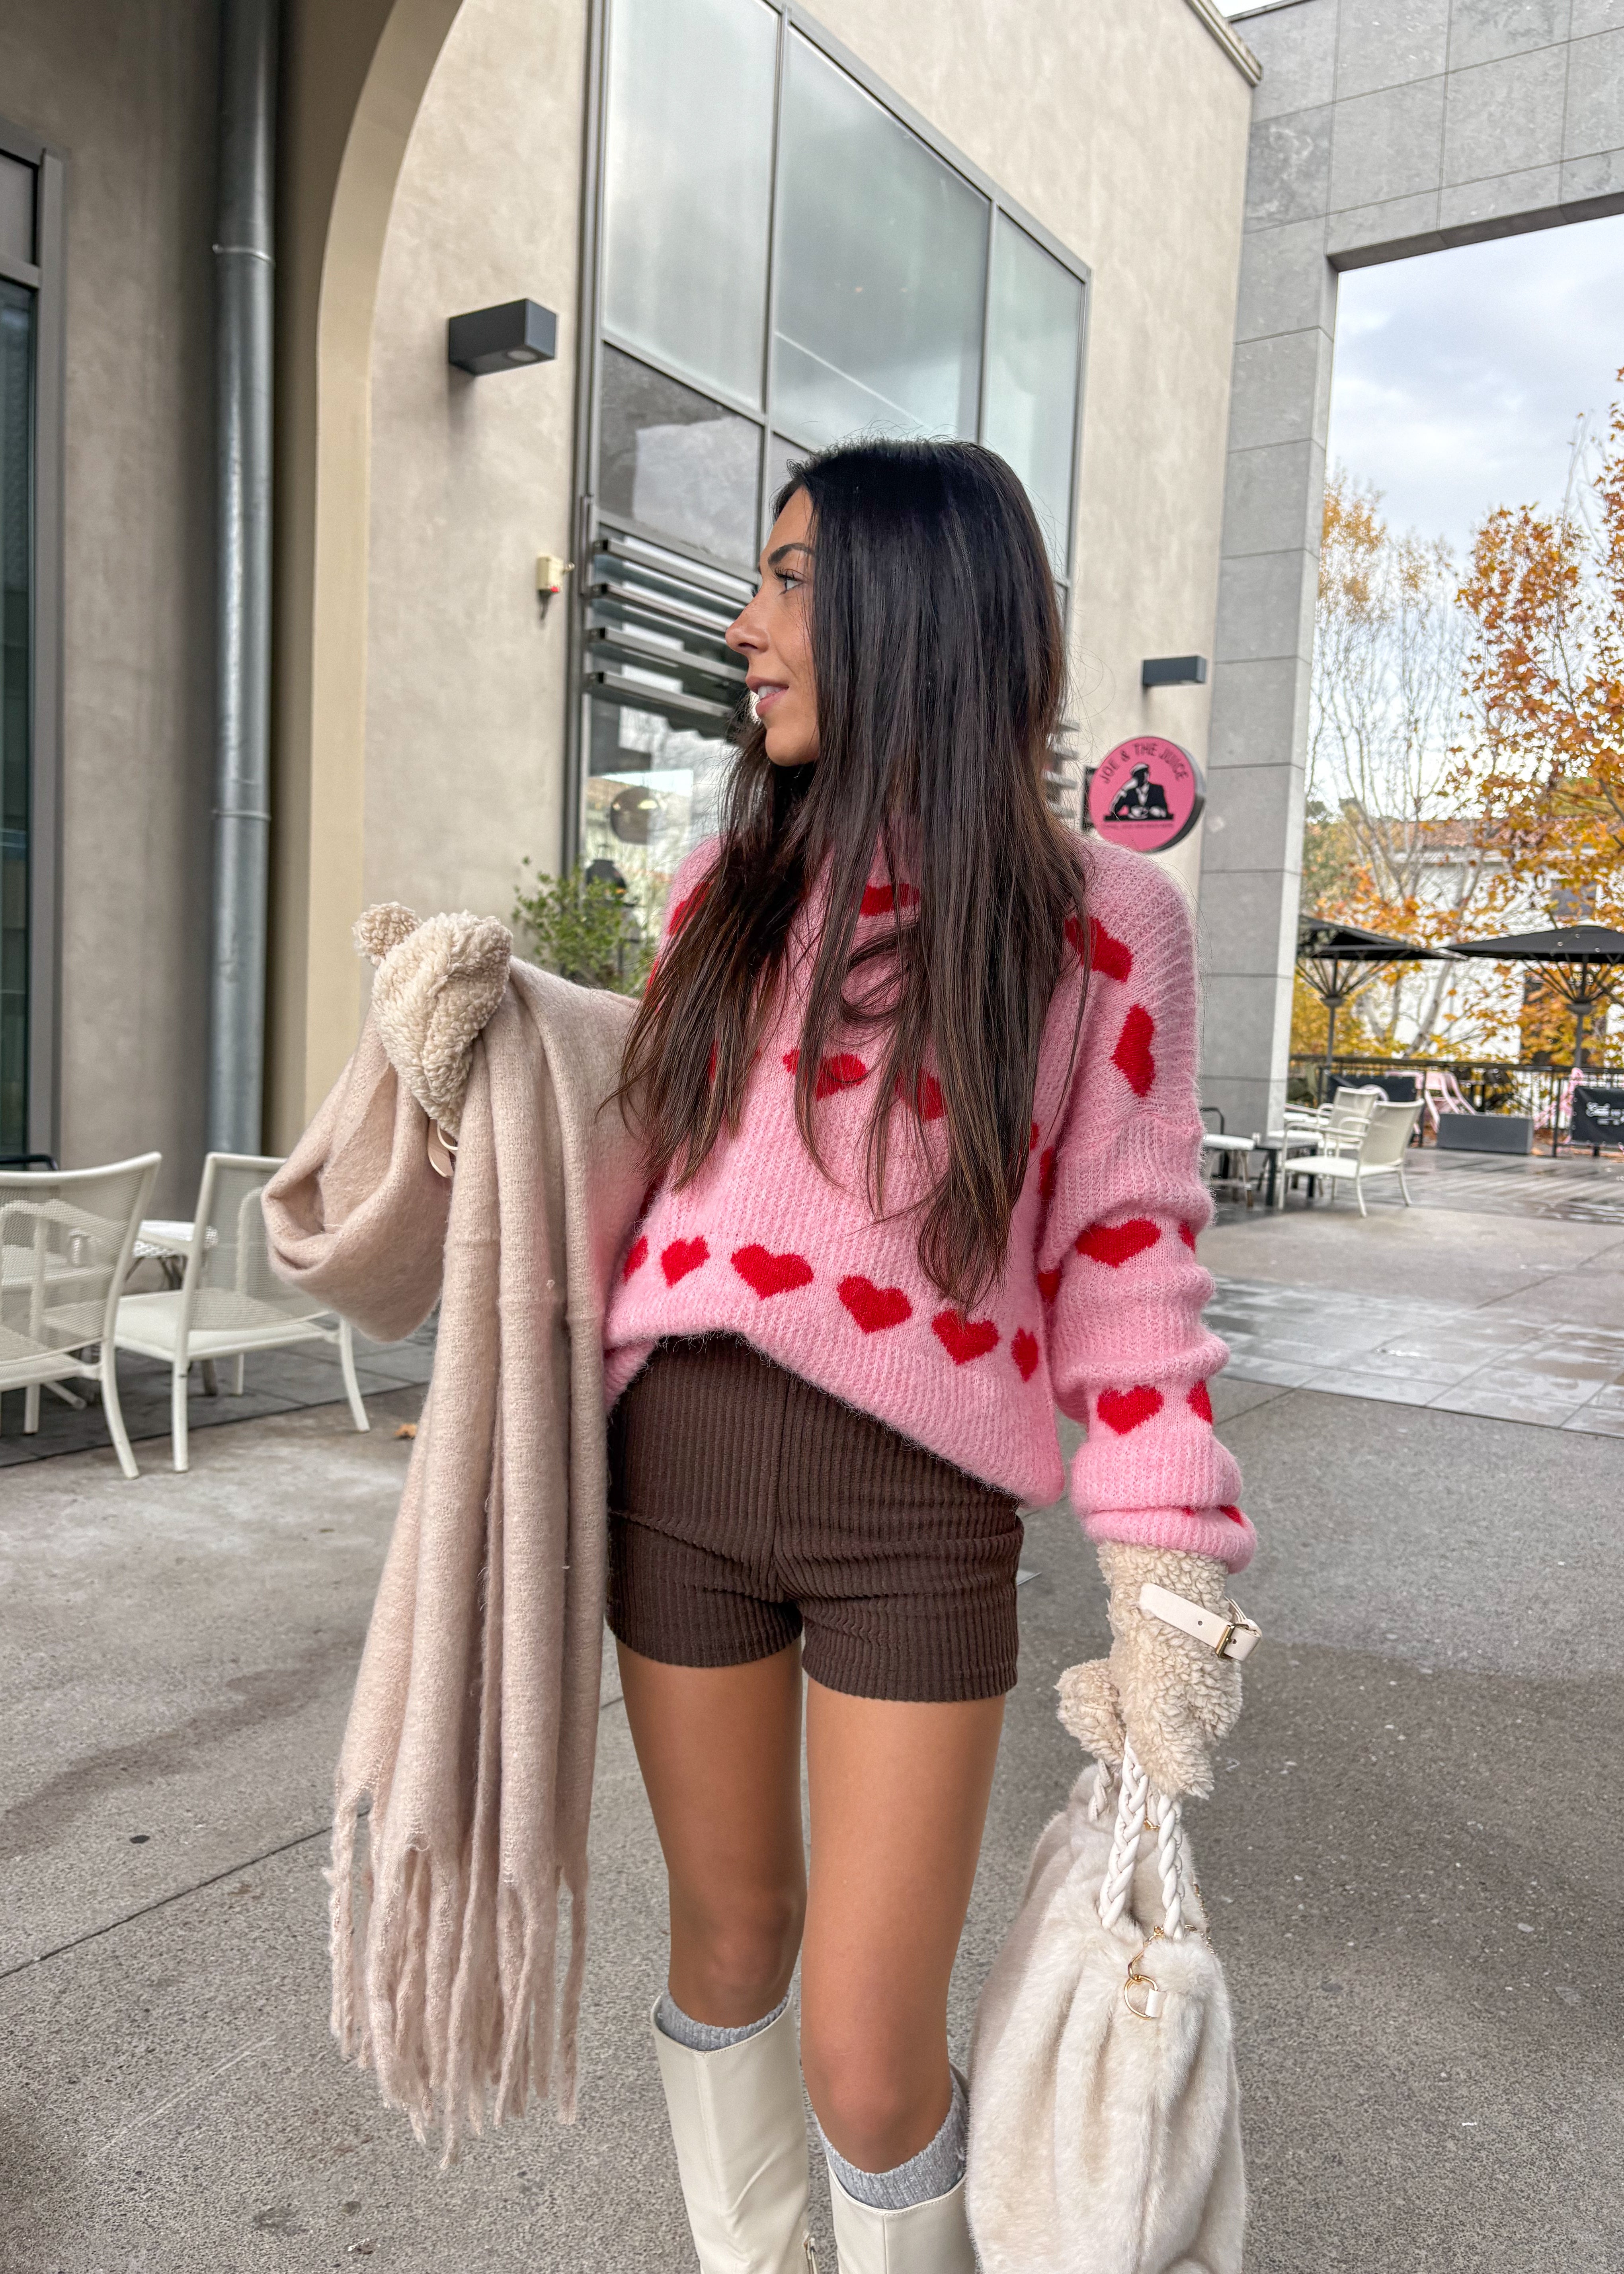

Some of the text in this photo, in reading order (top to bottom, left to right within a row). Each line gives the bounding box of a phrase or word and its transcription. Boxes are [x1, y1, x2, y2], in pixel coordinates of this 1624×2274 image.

[1100, 743, 1189, 784] JOE & THE JUICE
